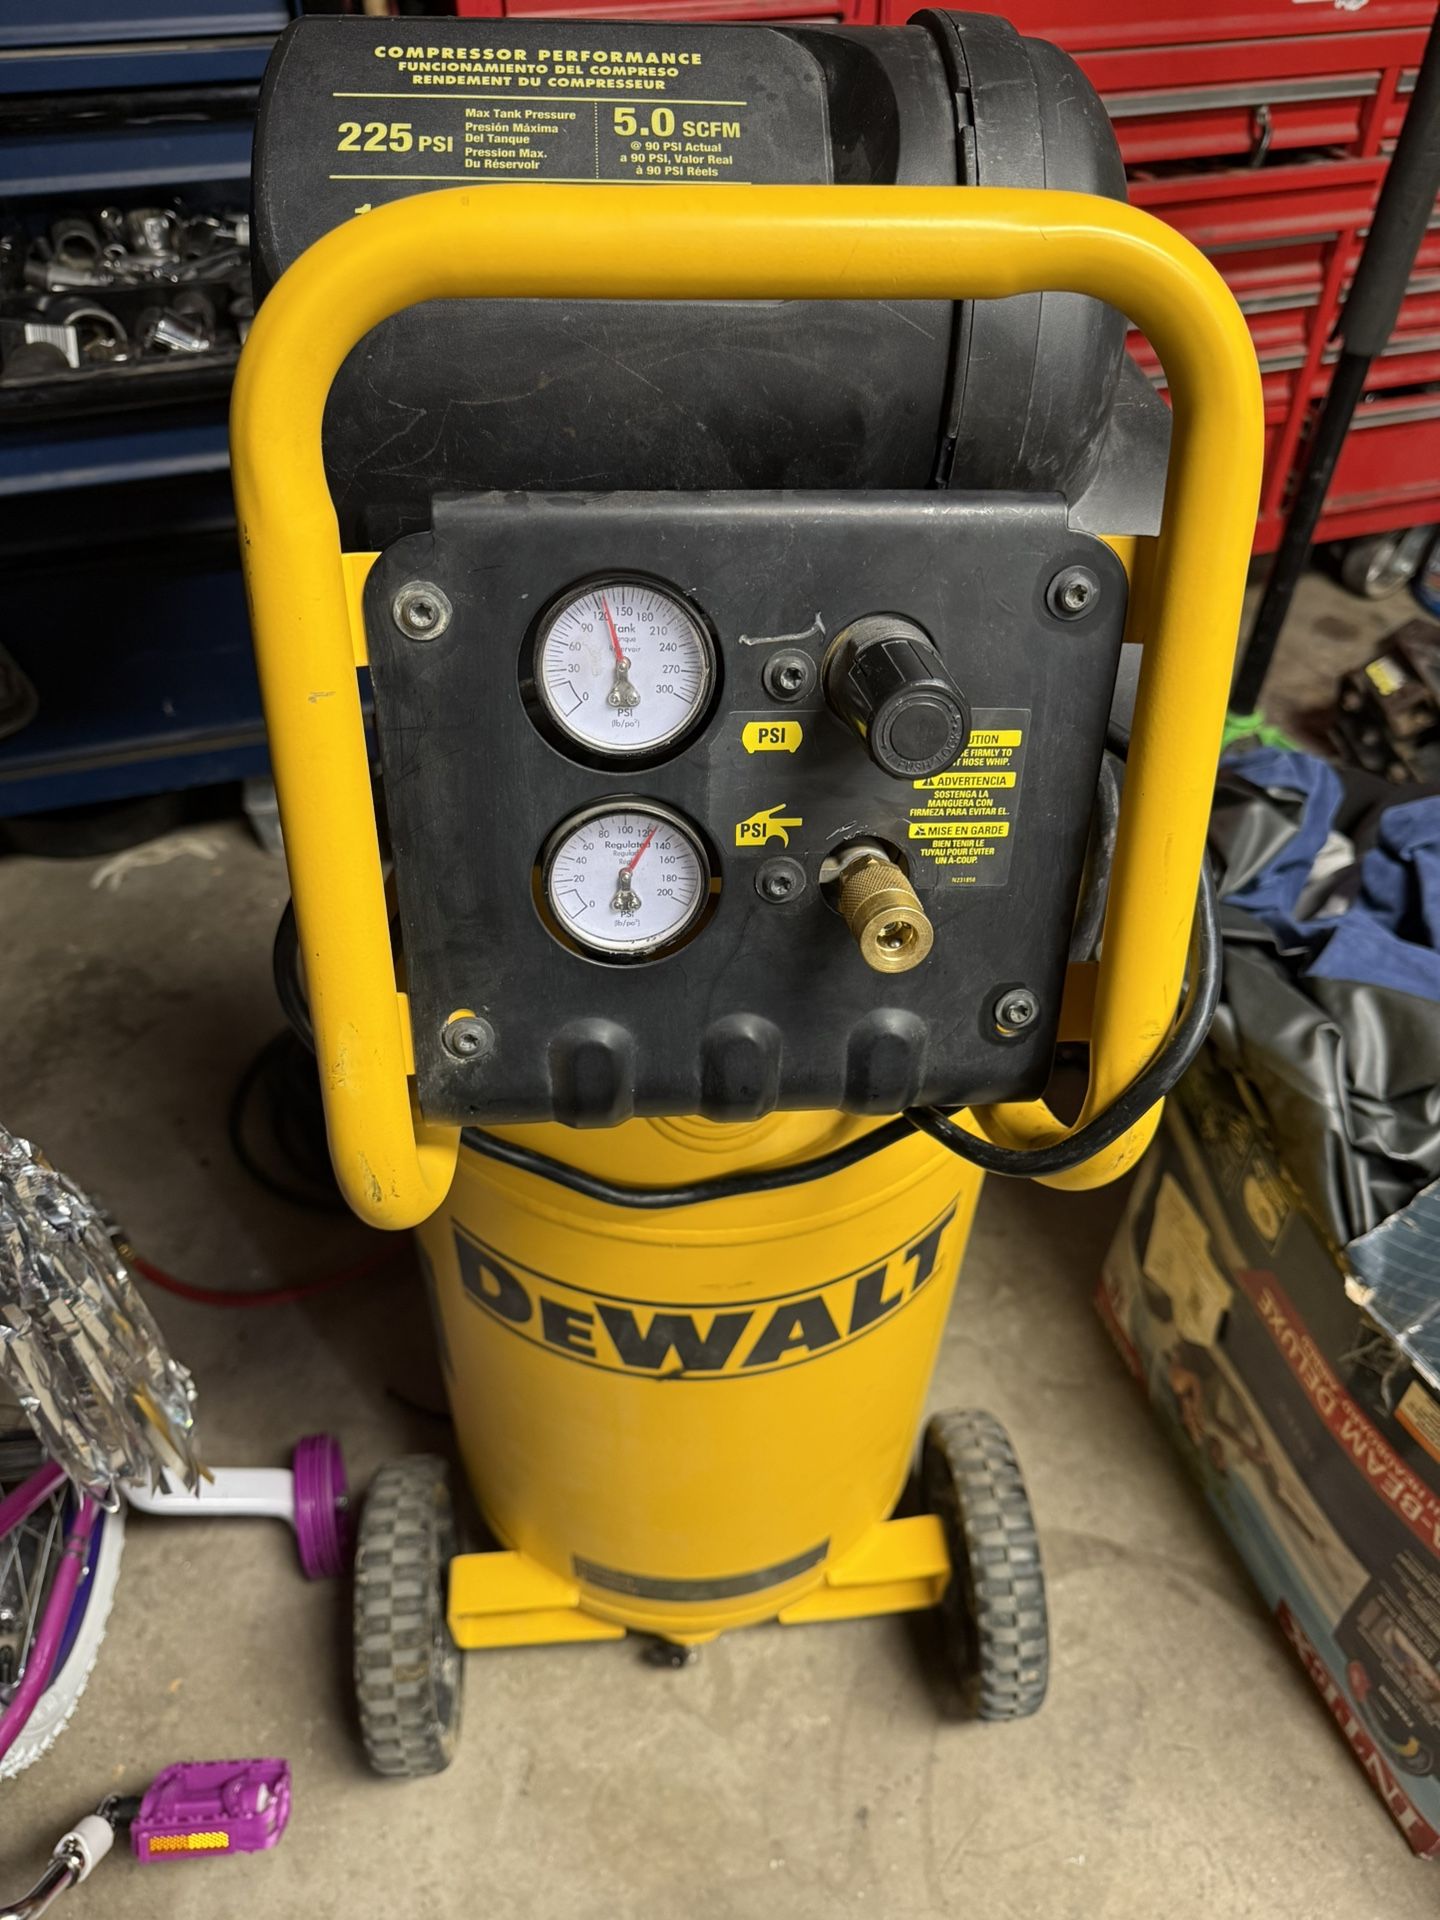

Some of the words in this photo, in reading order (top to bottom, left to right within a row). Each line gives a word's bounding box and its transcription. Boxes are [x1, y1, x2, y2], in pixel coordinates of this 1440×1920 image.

[374, 46, 527, 60] COMPRESSOR
[538, 50, 702, 64] PERFORMANCE
[398, 62, 548, 74] FUNCIONAMIENTO
[555, 65, 584, 75] DEL
[590, 66, 679, 77] COMPRESO
[412, 75, 512, 86] RENDEMENT
[518, 77, 541, 86] DU
[548, 78, 666, 90] COMPRESSEUR
[465, 108, 490, 118] Max
[493, 109, 522, 119] Tank
[525, 110, 576, 120] Pressure
[465, 122, 509, 132] Presión
[512, 123, 558, 133] Máxima
[614, 107, 675, 137] 5.0
[682, 121, 740, 138] SCFM
[337, 122, 413, 152] 225
[418, 136, 454, 152] PSI
[465, 134, 484, 142] Del
[487, 134, 530, 145] Tanque
[630, 141, 642, 150] @
[645, 142, 660, 151] 90
[663, 142, 682, 151] PSI
[685, 143, 722, 152] Actual
[465, 148, 516, 158] Pression
[519, 149, 548, 158] Max.
[464, 158, 480, 168] Du
[484, 159, 540, 169] Réservoir
[630, 154, 645, 162] 90
[649, 154, 671, 164] PSI,
[674, 154, 704, 164] Valor
[707, 155, 733, 165] Real
[636, 166, 642, 175] à
[646, 166, 661, 175] 90
[665, 166, 683, 175] PSI
[687, 166, 719, 176] Réels
[616, 606, 633, 616] 150
[636, 612, 654, 622] 180
[581, 624, 594, 632] 90
[650, 626, 668, 636] 210
[568, 642, 582, 651] 60
[659, 642, 677, 652] 240
[568, 664, 580, 673] 30
[662, 665, 680, 674] 270
[656, 684, 673, 694] 300
[582, 692, 589, 701] 0
[618, 708, 633, 717] PSI
[758, 728, 786, 744] PSI
[970, 749, 1000, 757] FIRMLY
[962, 758, 984, 766] HOSE
[986, 758, 1010, 766] WHIP.
[937, 776, 1006, 786] ADVERTENCIA
[934, 790, 977, 798] SOSTENGA
[979, 790, 988, 798] LA
[910, 808, 944, 816] FIRMEZA
[946, 808, 967, 816] PARA
[598, 830, 609, 838] 80
[617, 826, 633, 834] 100
[740, 823, 767, 838] PSI
[928, 826, 953, 835] MISE
[955, 826, 968, 835] EN
[971, 825, 1004, 835] GARDE
[583, 842, 594, 850] 60
[655, 842, 671, 850] 140
[932, 840, 951, 848] BIEN
[953, 839, 974, 847] TENIR
[976, 839, 985, 847] LE
[947, 848, 967, 856] POUR
[576, 856, 587, 864] 40
[660, 856, 675, 864] 160
[574, 875, 584, 883] 20
[453, 1203, 957, 1371] DEWALT
[1256, 1286, 1338, 1416] DELUXE
